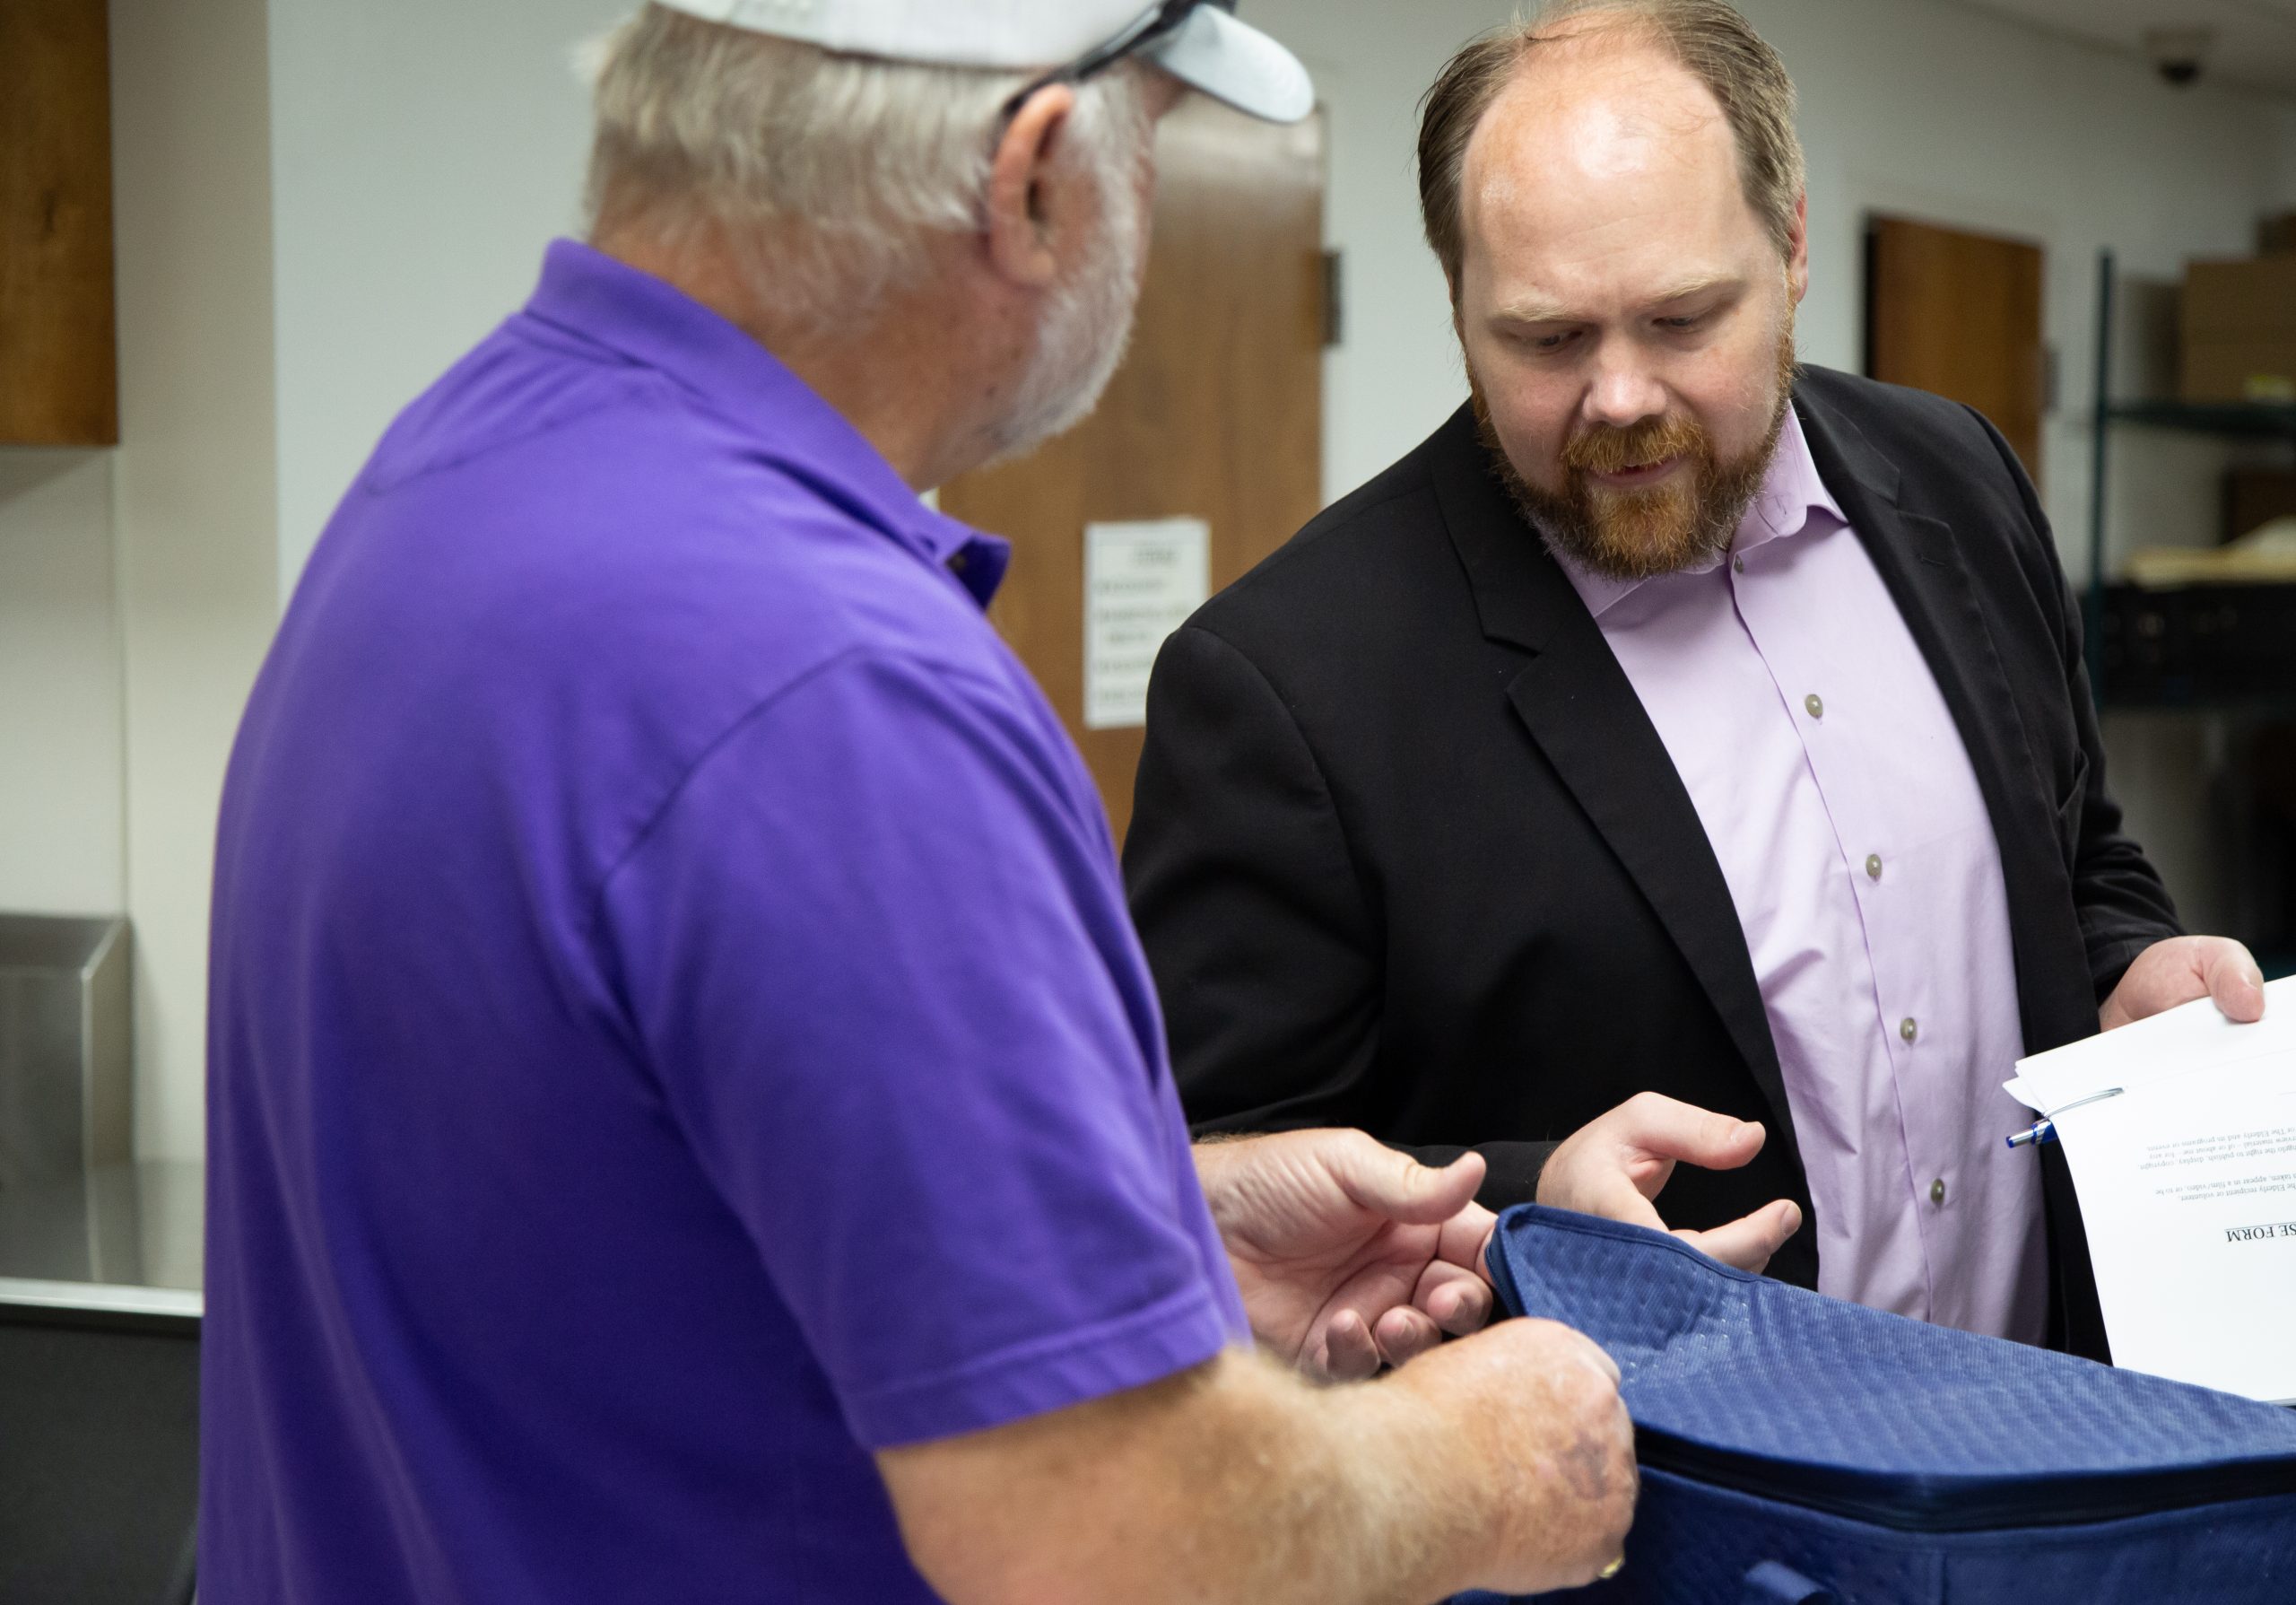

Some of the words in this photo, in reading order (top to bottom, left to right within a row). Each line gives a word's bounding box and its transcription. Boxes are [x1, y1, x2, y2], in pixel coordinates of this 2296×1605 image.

[2243, 1130, 2269, 1139] Elderly
[2181, 1136, 2215, 1146] programs
[2243, 1139, 2274, 1148] material
[2196, 1146, 2216, 1155] about
[2246, 1149, 2263, 1157] right
[2243, 1176, 2266, 1184] appear
[2226, 1187, 2257, 1197] recipient
[2259, 1183, 2285, 1193] Elderly
[2226, 1226, 2274, 1243] FORM
